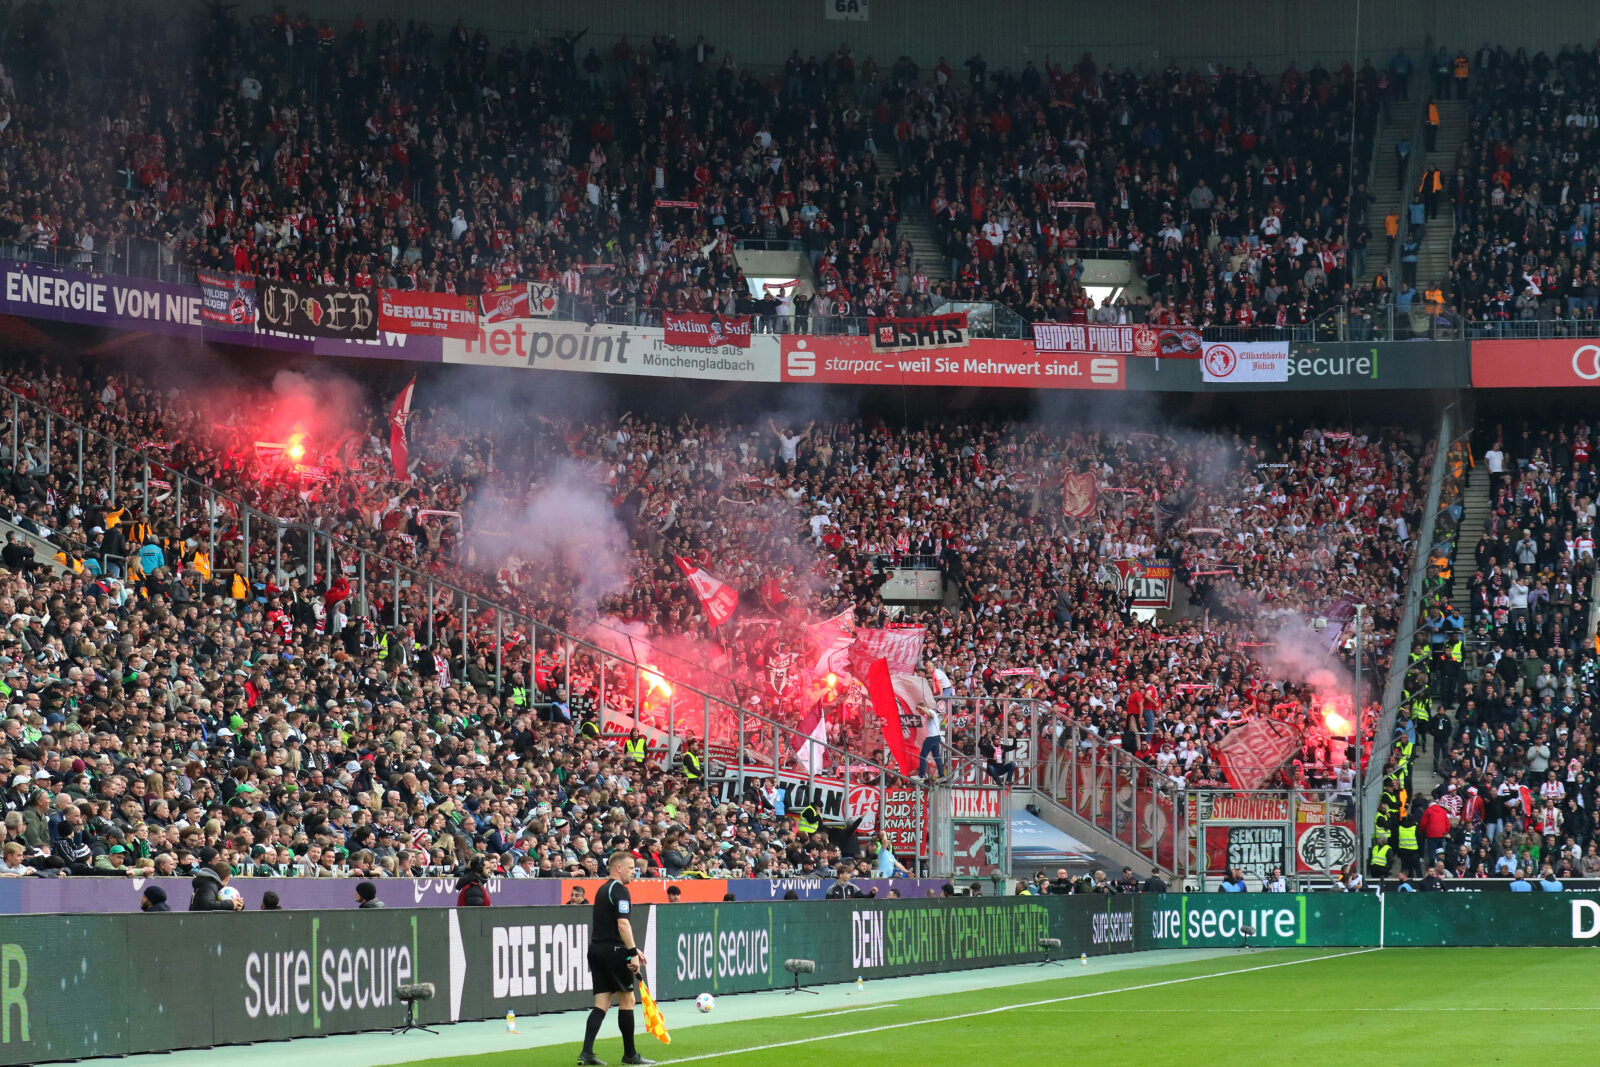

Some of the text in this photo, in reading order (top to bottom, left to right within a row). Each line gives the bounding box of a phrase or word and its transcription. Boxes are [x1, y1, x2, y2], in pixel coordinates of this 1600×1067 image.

[6, 271, 202, 326] ENERGIE VOM NIE
[202, 286, 229, 300] WILDER
[382, 302, 476, 324] GEROLSTEIN
[410, 320, 430, 328] SINCE
[667, 317, 749, 335] Sektion Suff
[464, 323, 630, 365] netpoint
[1034, 325, 1133, 353] SEMPER FIDELIS
[722, 345, 744, 356] aus
[643, 353, 755, 371] Mönchengladbach
[824, 357, 882, 375] starpac
[898, 357, 931, 373] weil
[935, 357, 959, 373] Sie
[963, 358, 1041, 375] Mehrwert
[1045, 360, 1083, 376] sind.
[1251, 361, 1275, 372] Jülich
[779, 780, 843, 817] KÖLN
[886, 790, 925, 803] LEEVER
[950, 789, 998, 817] NDIKAT
[885, 804, 911, 818] DUD
[885, 815, 925, 830] KNÄÄCH
[1230, 828, 1283, 844] SEKTION
[1229, 843, 1282, 864] STADT
[852, 903, 1050, 969] DEIN SECURITY OPERATION CENTER
[492, 923, 594, 999] DIE FOHL
